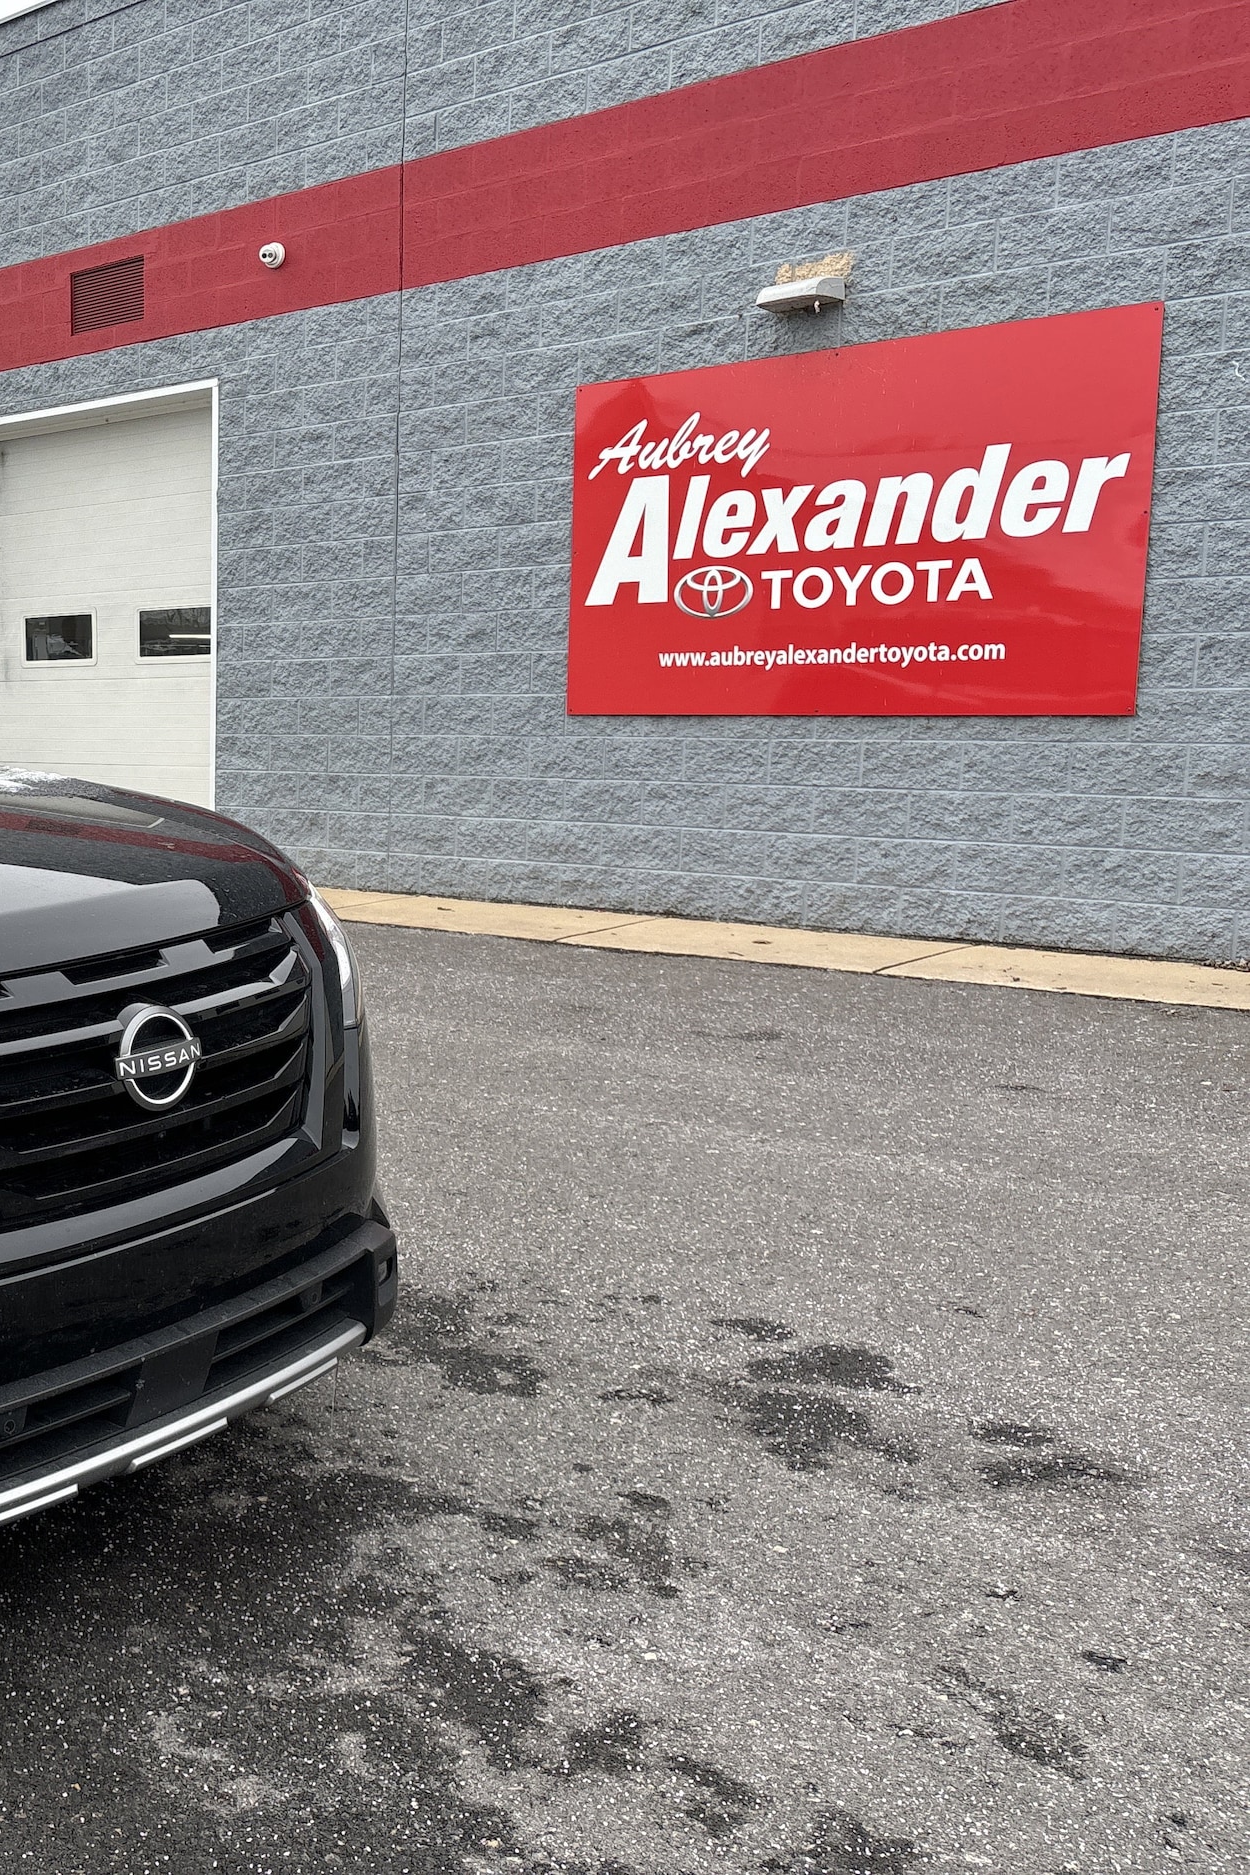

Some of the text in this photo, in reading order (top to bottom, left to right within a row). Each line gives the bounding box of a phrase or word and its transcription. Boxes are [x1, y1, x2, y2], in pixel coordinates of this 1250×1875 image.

[588, 412, 771, 480] Aubrey
[585, 444, 1131, 607] Alexander
[760, 558, 993, 610] TOYOTA
[658, 641, 1006, 671] www.aubreyalexandertoyota.com
[118, 1042, 201, 1077] NISSAN
